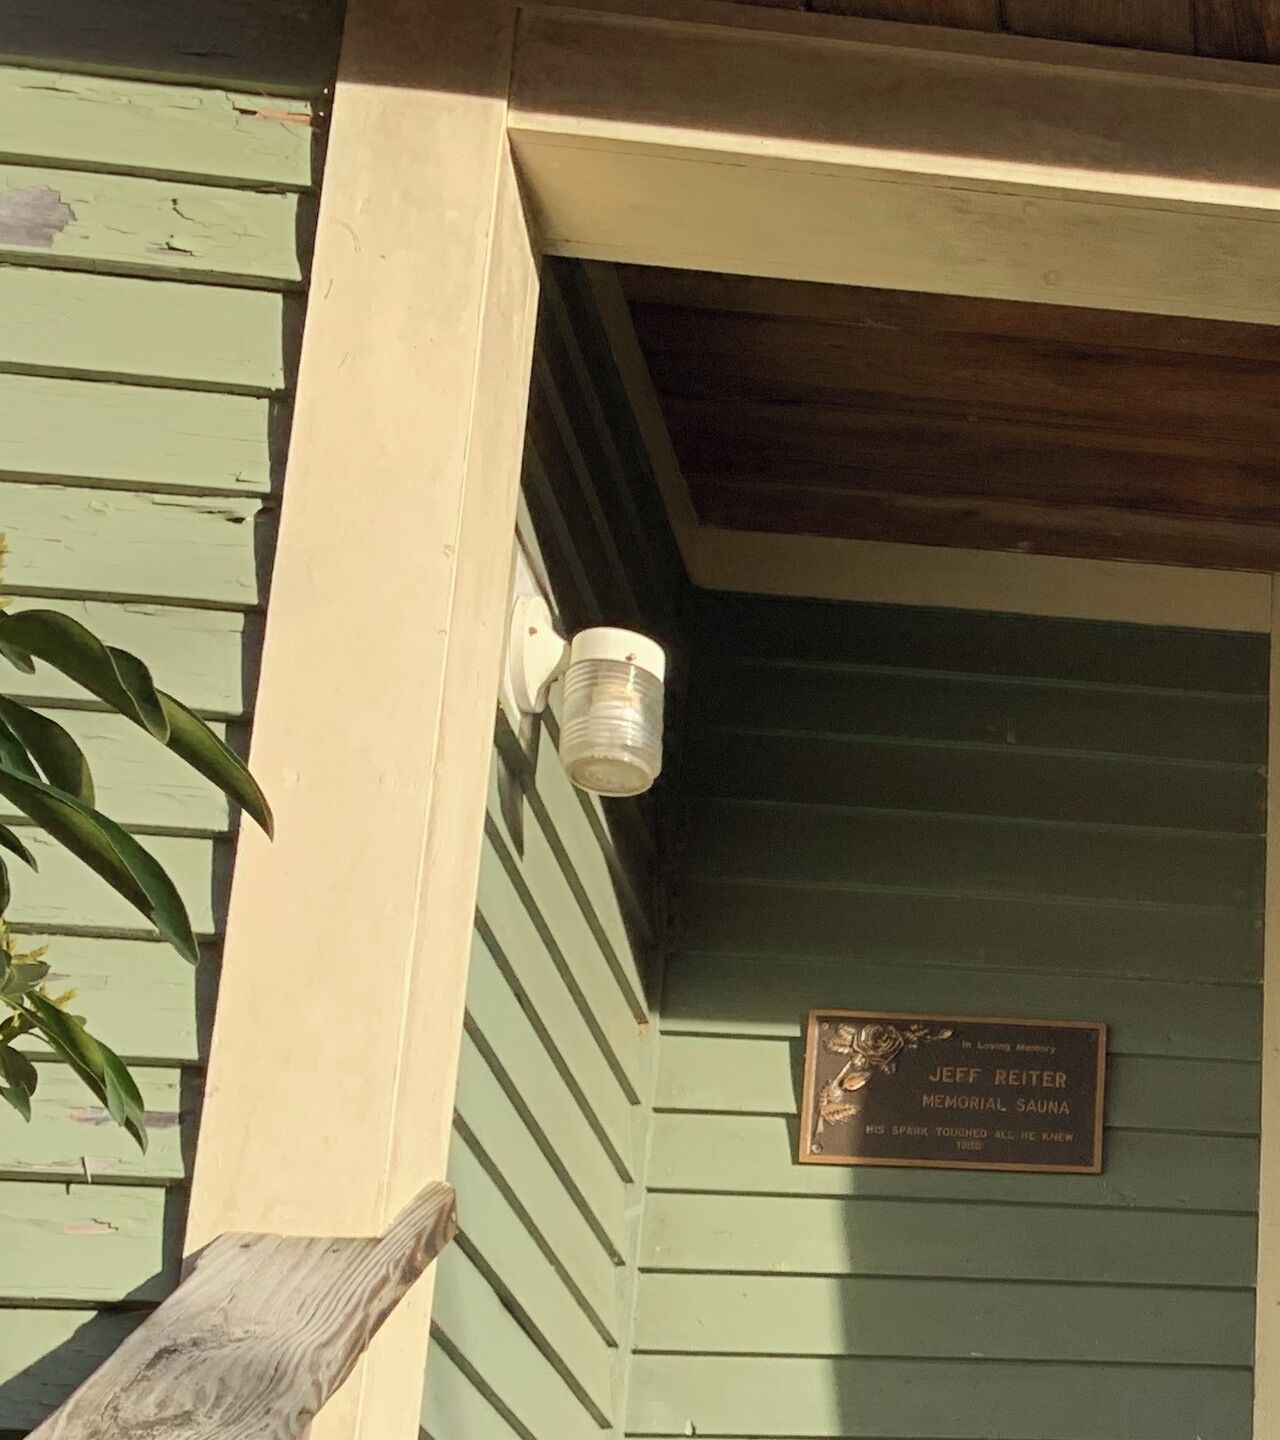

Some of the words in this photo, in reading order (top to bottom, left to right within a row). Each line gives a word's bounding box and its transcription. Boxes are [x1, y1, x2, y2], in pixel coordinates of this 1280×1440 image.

[929, 1066, 981, 1084] JEFF
[994, 1069, 1066, 1089] REITER
[923, 1094, 1006, 1112] MEMORIAL
[1016, 1098, 1070, 1114] SAUNA
[865, 1125, 885, 1135] HIS
[892, 1126, 928, 1136] SPARK
[936, 1127, 987, 1138] TOUCHED
[994, 1129, 1014, 1140] ALL
[1020, 1130, 1036, 1141] HE
[1042, 1131, 1074, 1142] KNEW
